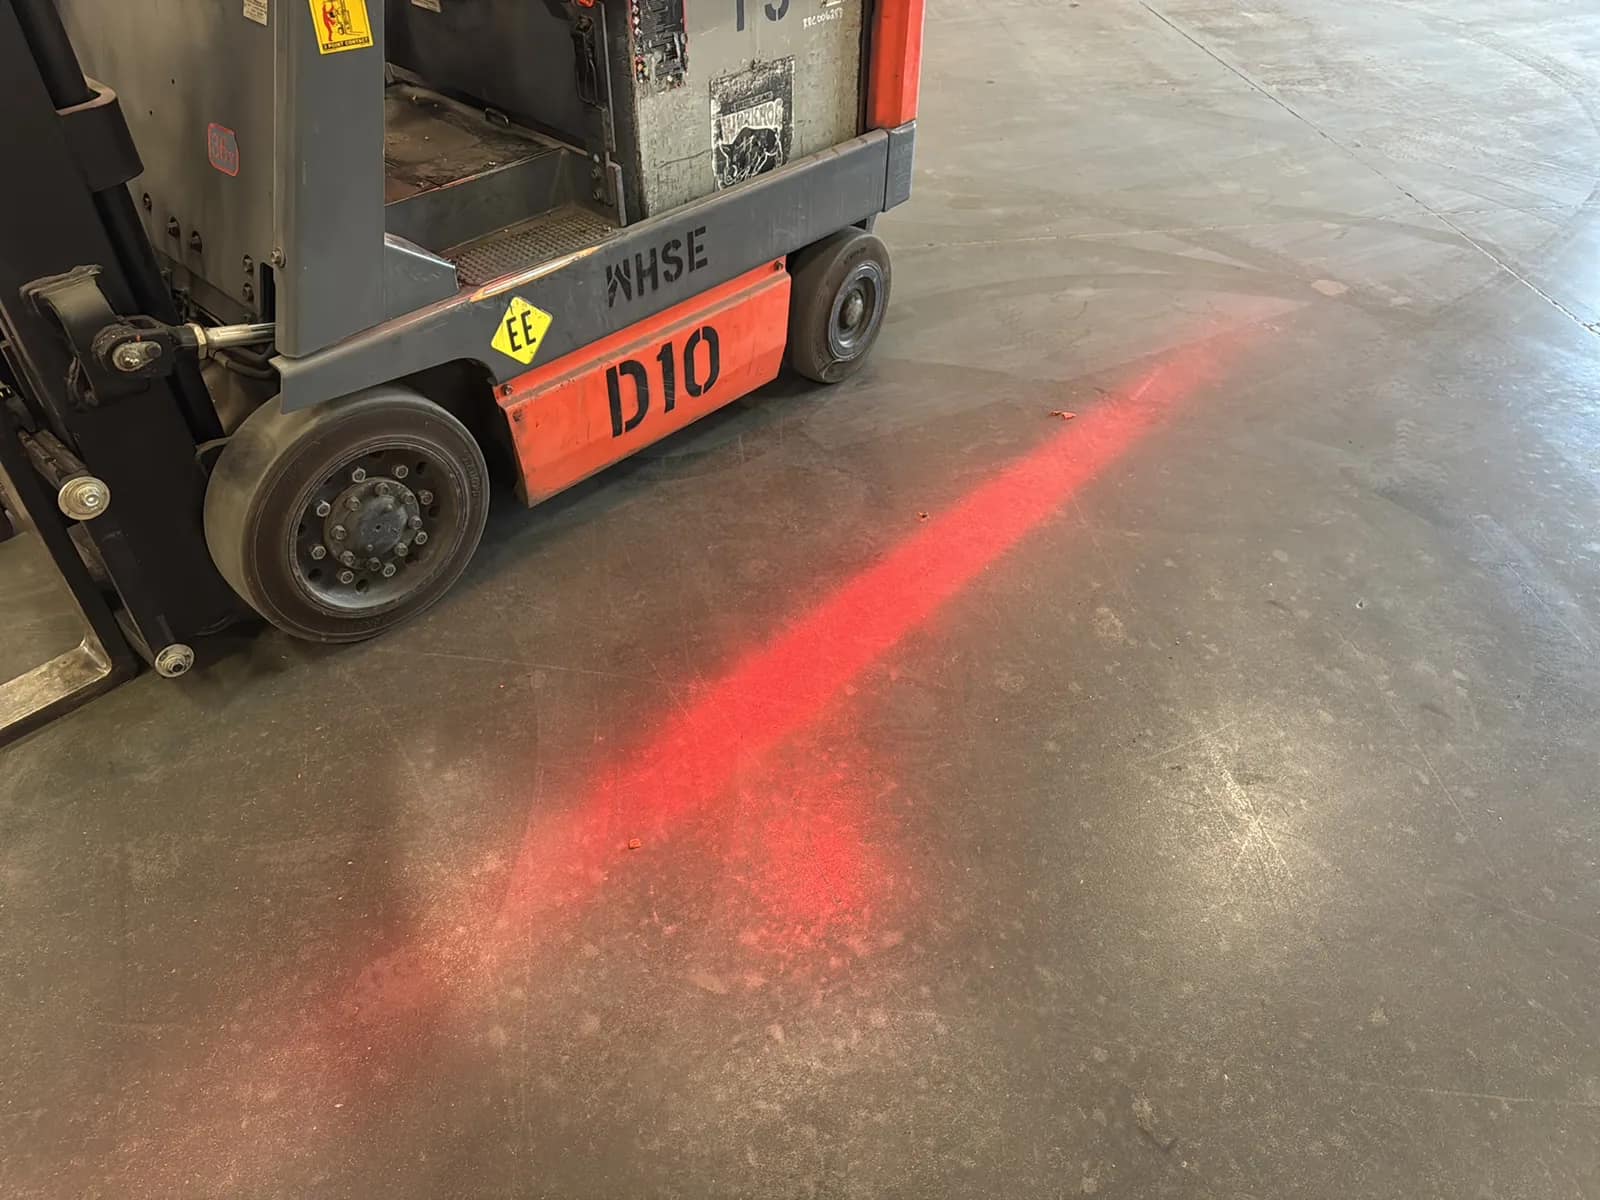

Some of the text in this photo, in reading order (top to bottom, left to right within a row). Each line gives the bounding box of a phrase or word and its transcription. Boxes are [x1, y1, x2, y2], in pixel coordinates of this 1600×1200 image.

[328, 40, 345, 49] POINT
[344, 36, 370, 46] CONTACT
[606, 226, 708, 308] WHSE
[506, 310, 537, 353] EE
[606, 326, 720, 438] D10
